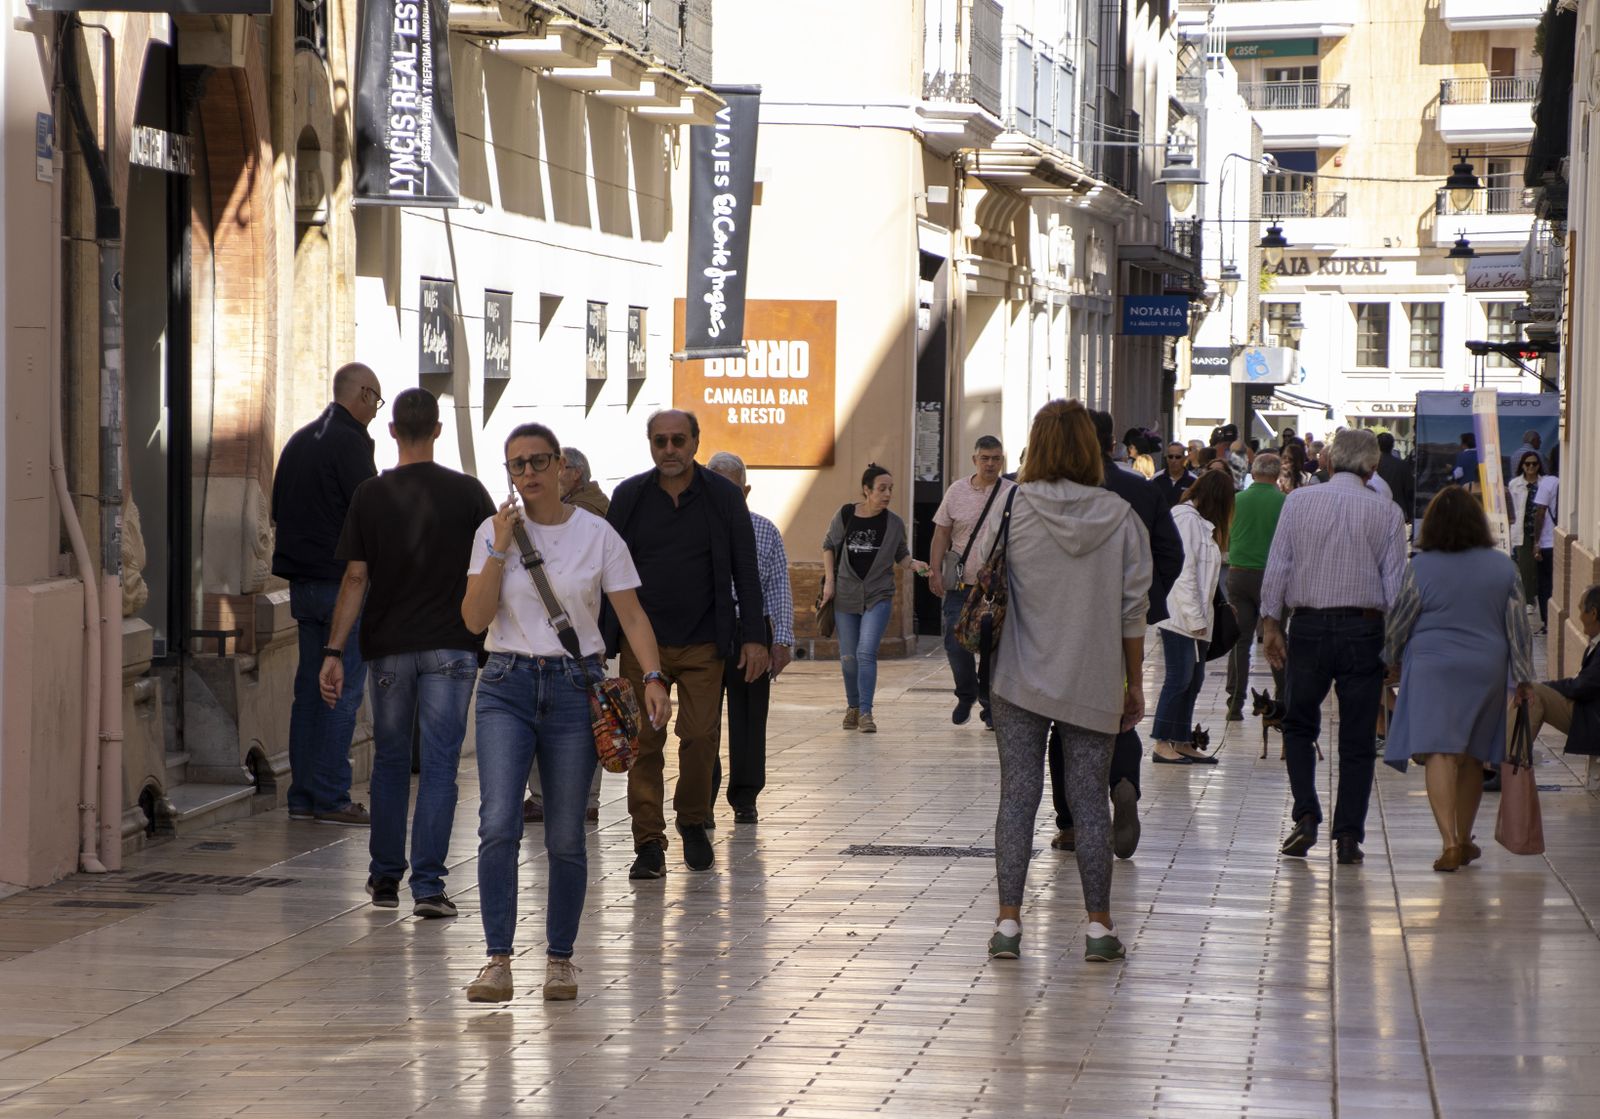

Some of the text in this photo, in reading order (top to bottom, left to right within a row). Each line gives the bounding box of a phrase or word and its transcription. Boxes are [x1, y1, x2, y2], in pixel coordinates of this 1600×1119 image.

[1234, 45, 1259, 56] caser
[422, 42, 432, 85] REFORMA
[389, 0, 419, 196] LYNCIS REAL ES
[703, 106, 737, 338] VIAJES El Corte Inglés
[1317, 256, 1387, 276] RURAL
[1130, 304, 1183, 316] NOTARÍA
[1191, 357, 1229, 366] MANGO
[703, 387, 809, 405] CANAGLIA BAR
[727, 407, 786, 425] & RESTO
